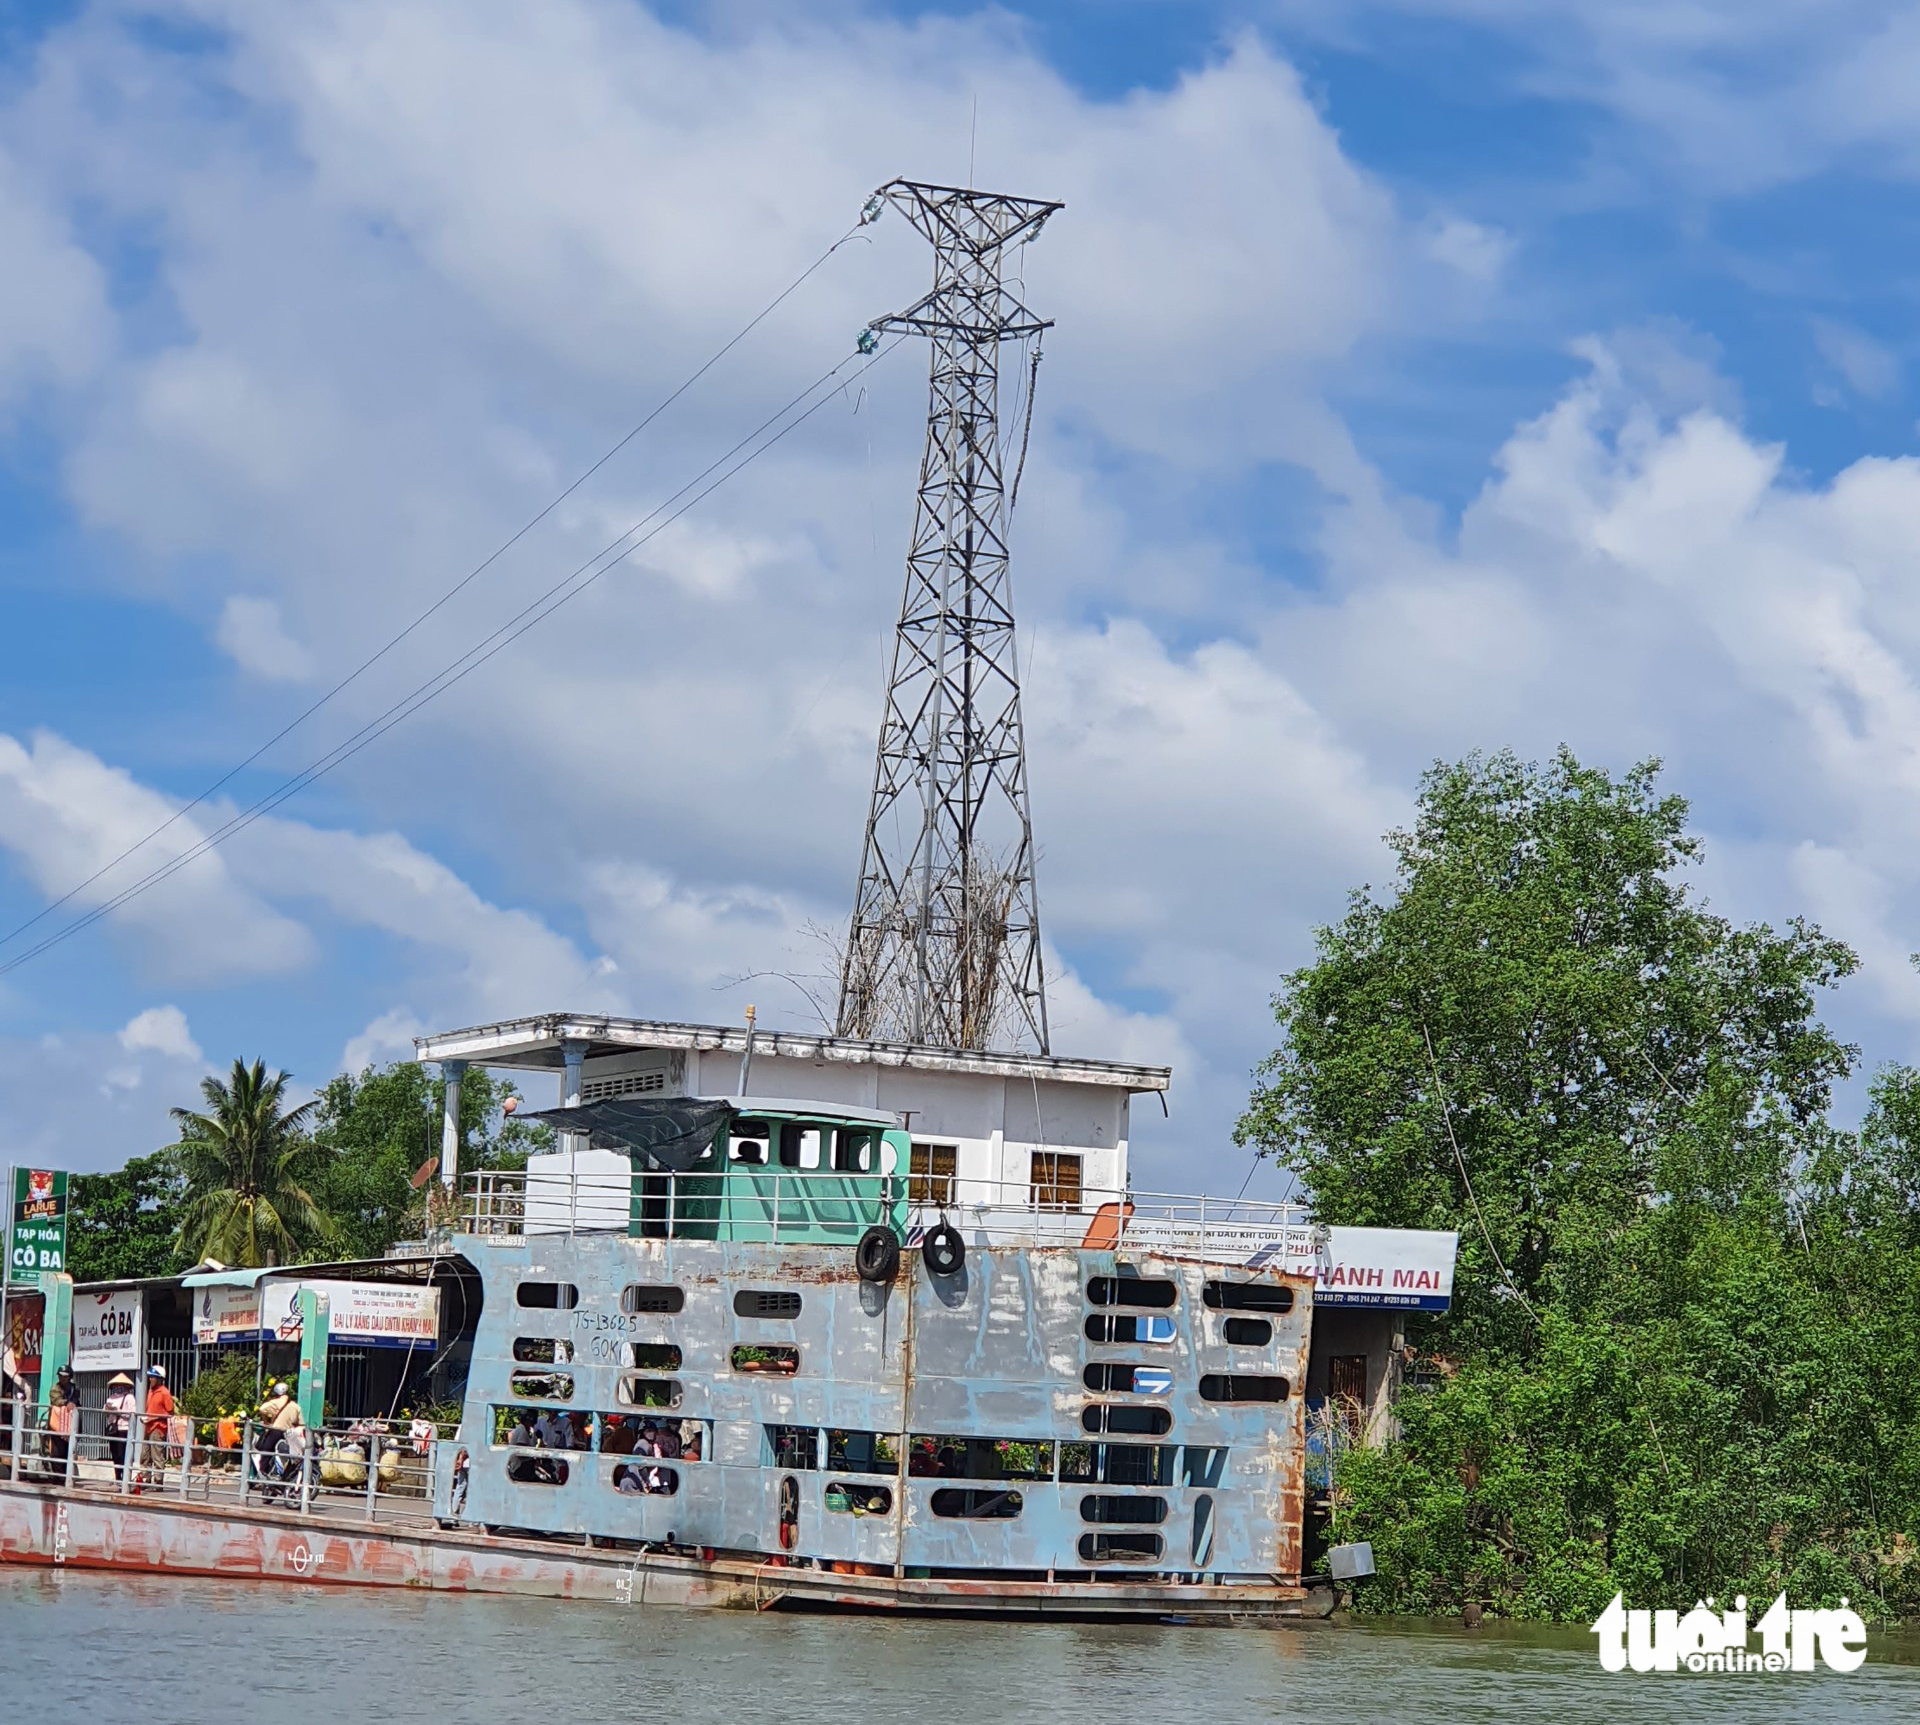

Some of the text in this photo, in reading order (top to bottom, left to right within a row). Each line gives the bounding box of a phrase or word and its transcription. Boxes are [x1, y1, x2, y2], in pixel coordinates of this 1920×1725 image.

[24, 1200, 57, 1215] LARUE
[17, 1227, 60, 1241] TẠP HÓA
[13, 1245, 62, 1269] CÔ BA
[1297, 1262, 1440, 1290] KHÁNH MAI
[100, 1305, 117, 1337] CÔ
[119, 1311, 133, 1336] BA
[24, 1328, 42, 1356] SA
